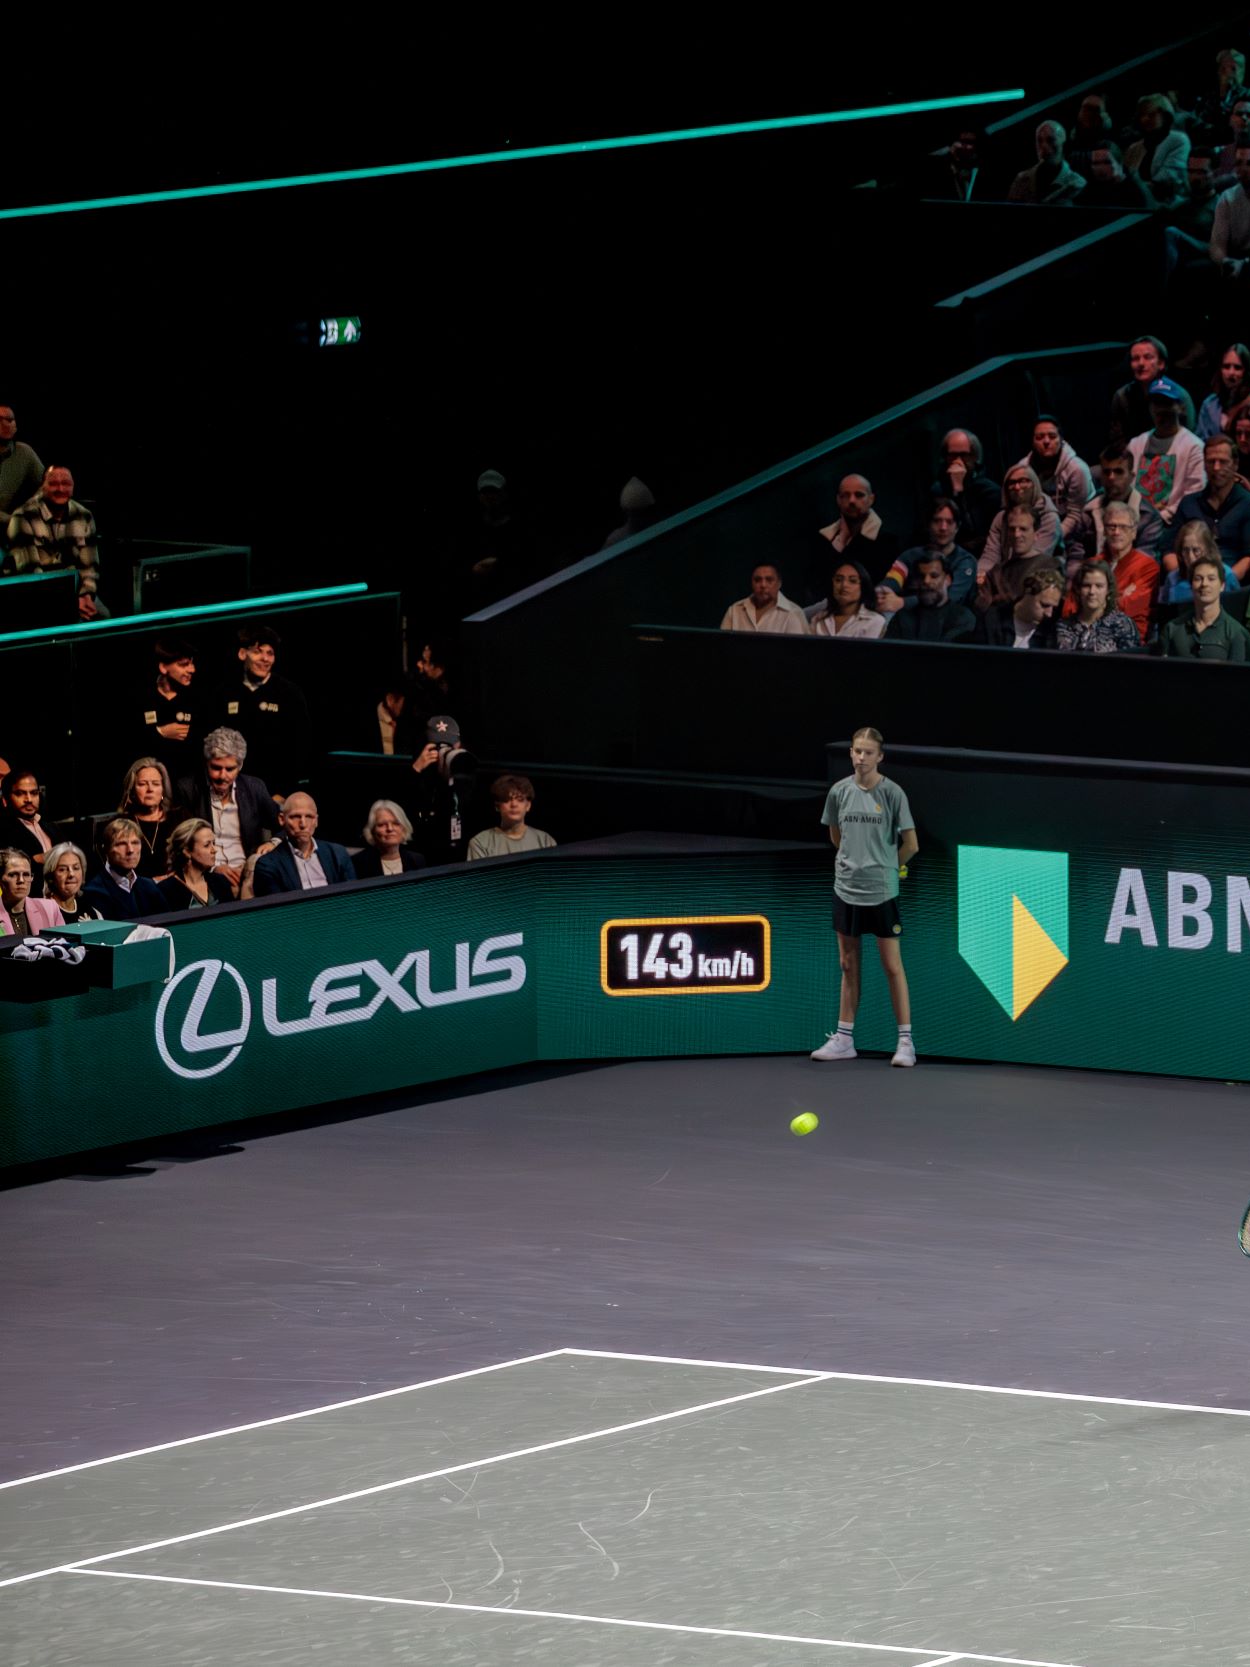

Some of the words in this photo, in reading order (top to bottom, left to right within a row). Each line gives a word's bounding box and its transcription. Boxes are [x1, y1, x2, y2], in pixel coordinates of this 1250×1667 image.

[262, 933, 526, 1036] LEXUS
[621, 932, 693, 980] 143
[698, 951, 754, 979] km/h
